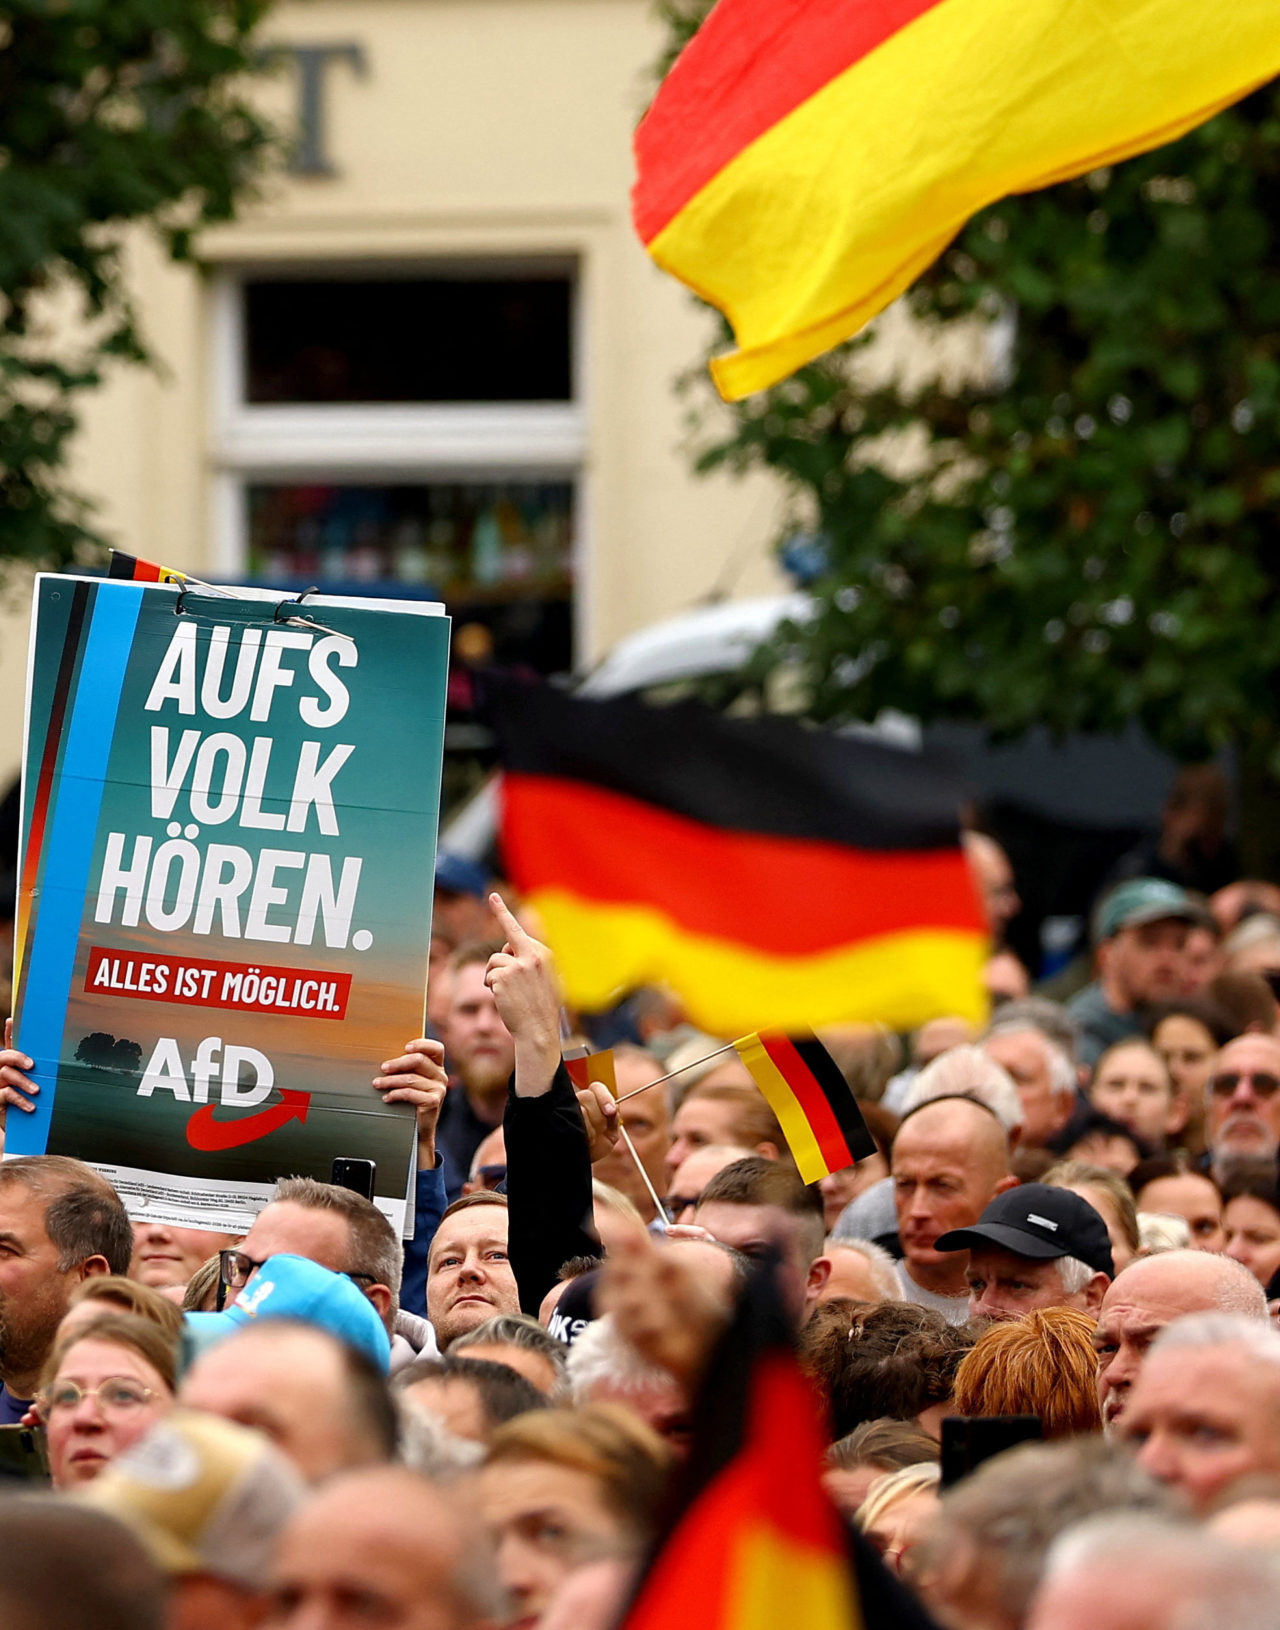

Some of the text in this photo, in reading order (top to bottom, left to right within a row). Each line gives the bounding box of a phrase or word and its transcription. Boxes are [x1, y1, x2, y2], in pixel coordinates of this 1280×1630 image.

[144, 621, 358, 729] AUFS
[150, 725, 356, 837] VOLK
[94, 821, 374, 951] HÖREN.
[93, 958, 340, 1012] ALLES IST MÖGLICH.
[136, 1036, 275, 1108] AfD
